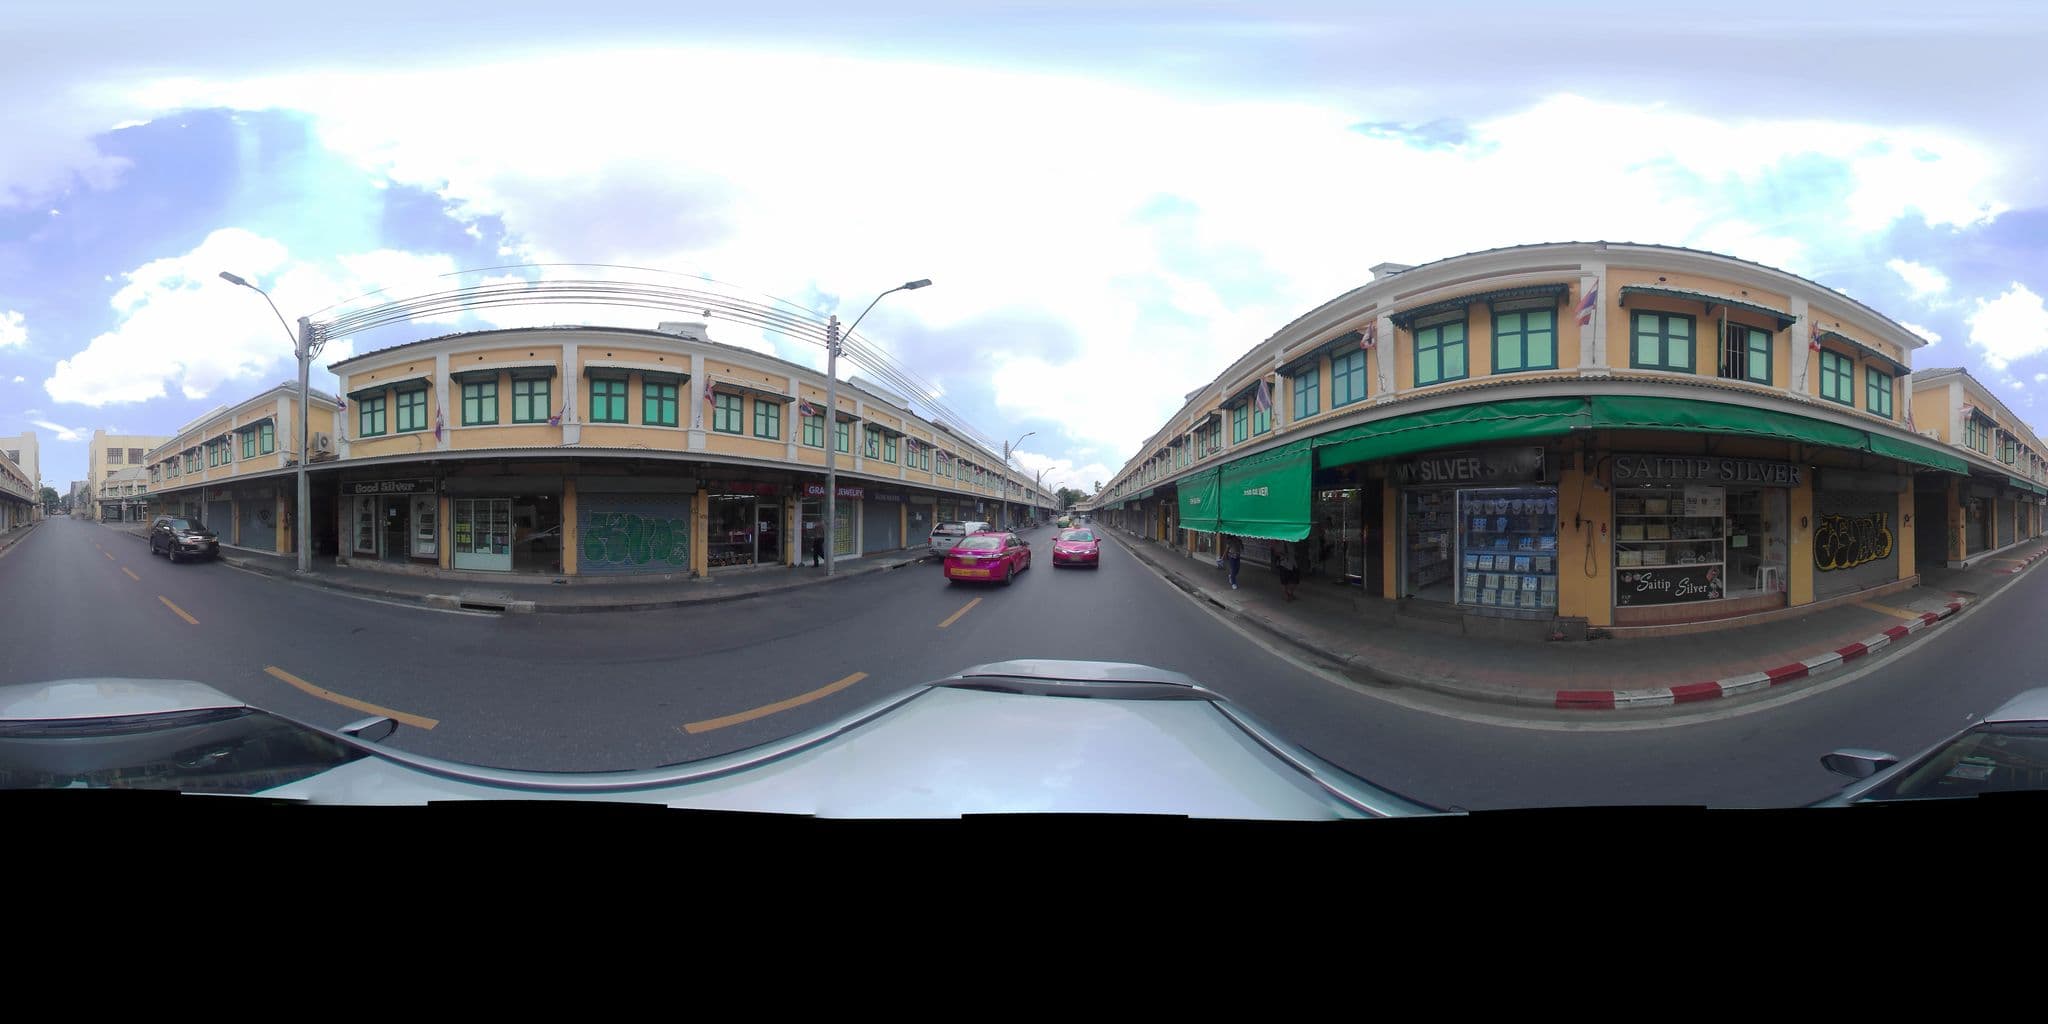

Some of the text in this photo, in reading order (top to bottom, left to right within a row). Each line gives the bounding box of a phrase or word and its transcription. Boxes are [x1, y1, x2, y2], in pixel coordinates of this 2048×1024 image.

[1420, 458, 1481, 481] SILVER
[1614, 457, 1799, 484] SAITIP SILVER
[355, 482, 415, 493] Good Silver
[1637, 573, 1707, 597] Saitip Silver
